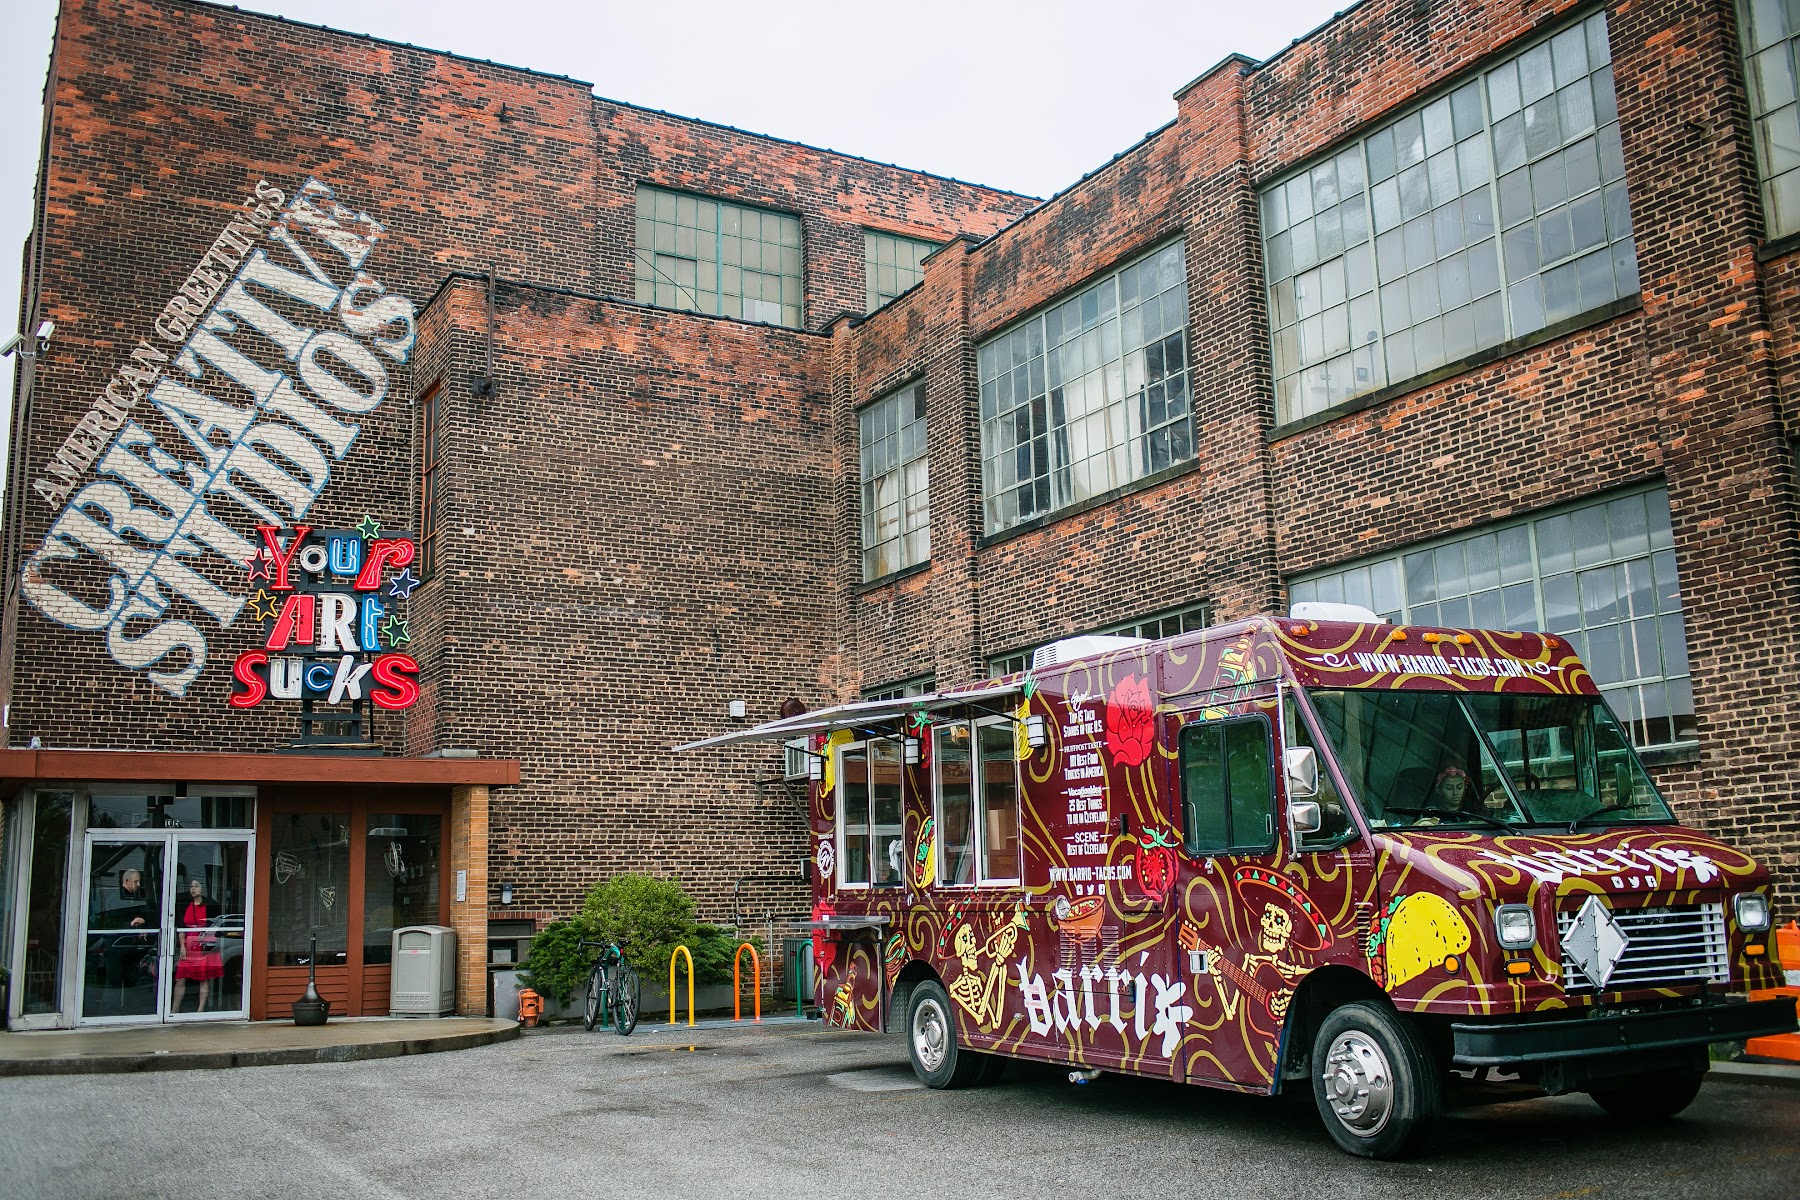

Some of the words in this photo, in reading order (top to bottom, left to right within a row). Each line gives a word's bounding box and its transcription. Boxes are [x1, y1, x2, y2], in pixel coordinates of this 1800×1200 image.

[20, 175, 386, 630] CREATIVE
[32, 341, 170, 510] AMERICAN
[155, 179, 286, 343] GREETINGS
[107, 268, 418, 698] STUDIOS
[1353, 652, 1528, 678] WWW.BARRIO-TACOS.COM
[1049, 865, 1132, 881] WWW.BARRIO-TACOS.COM
[1075, 831, 1099, 843] SCENE
